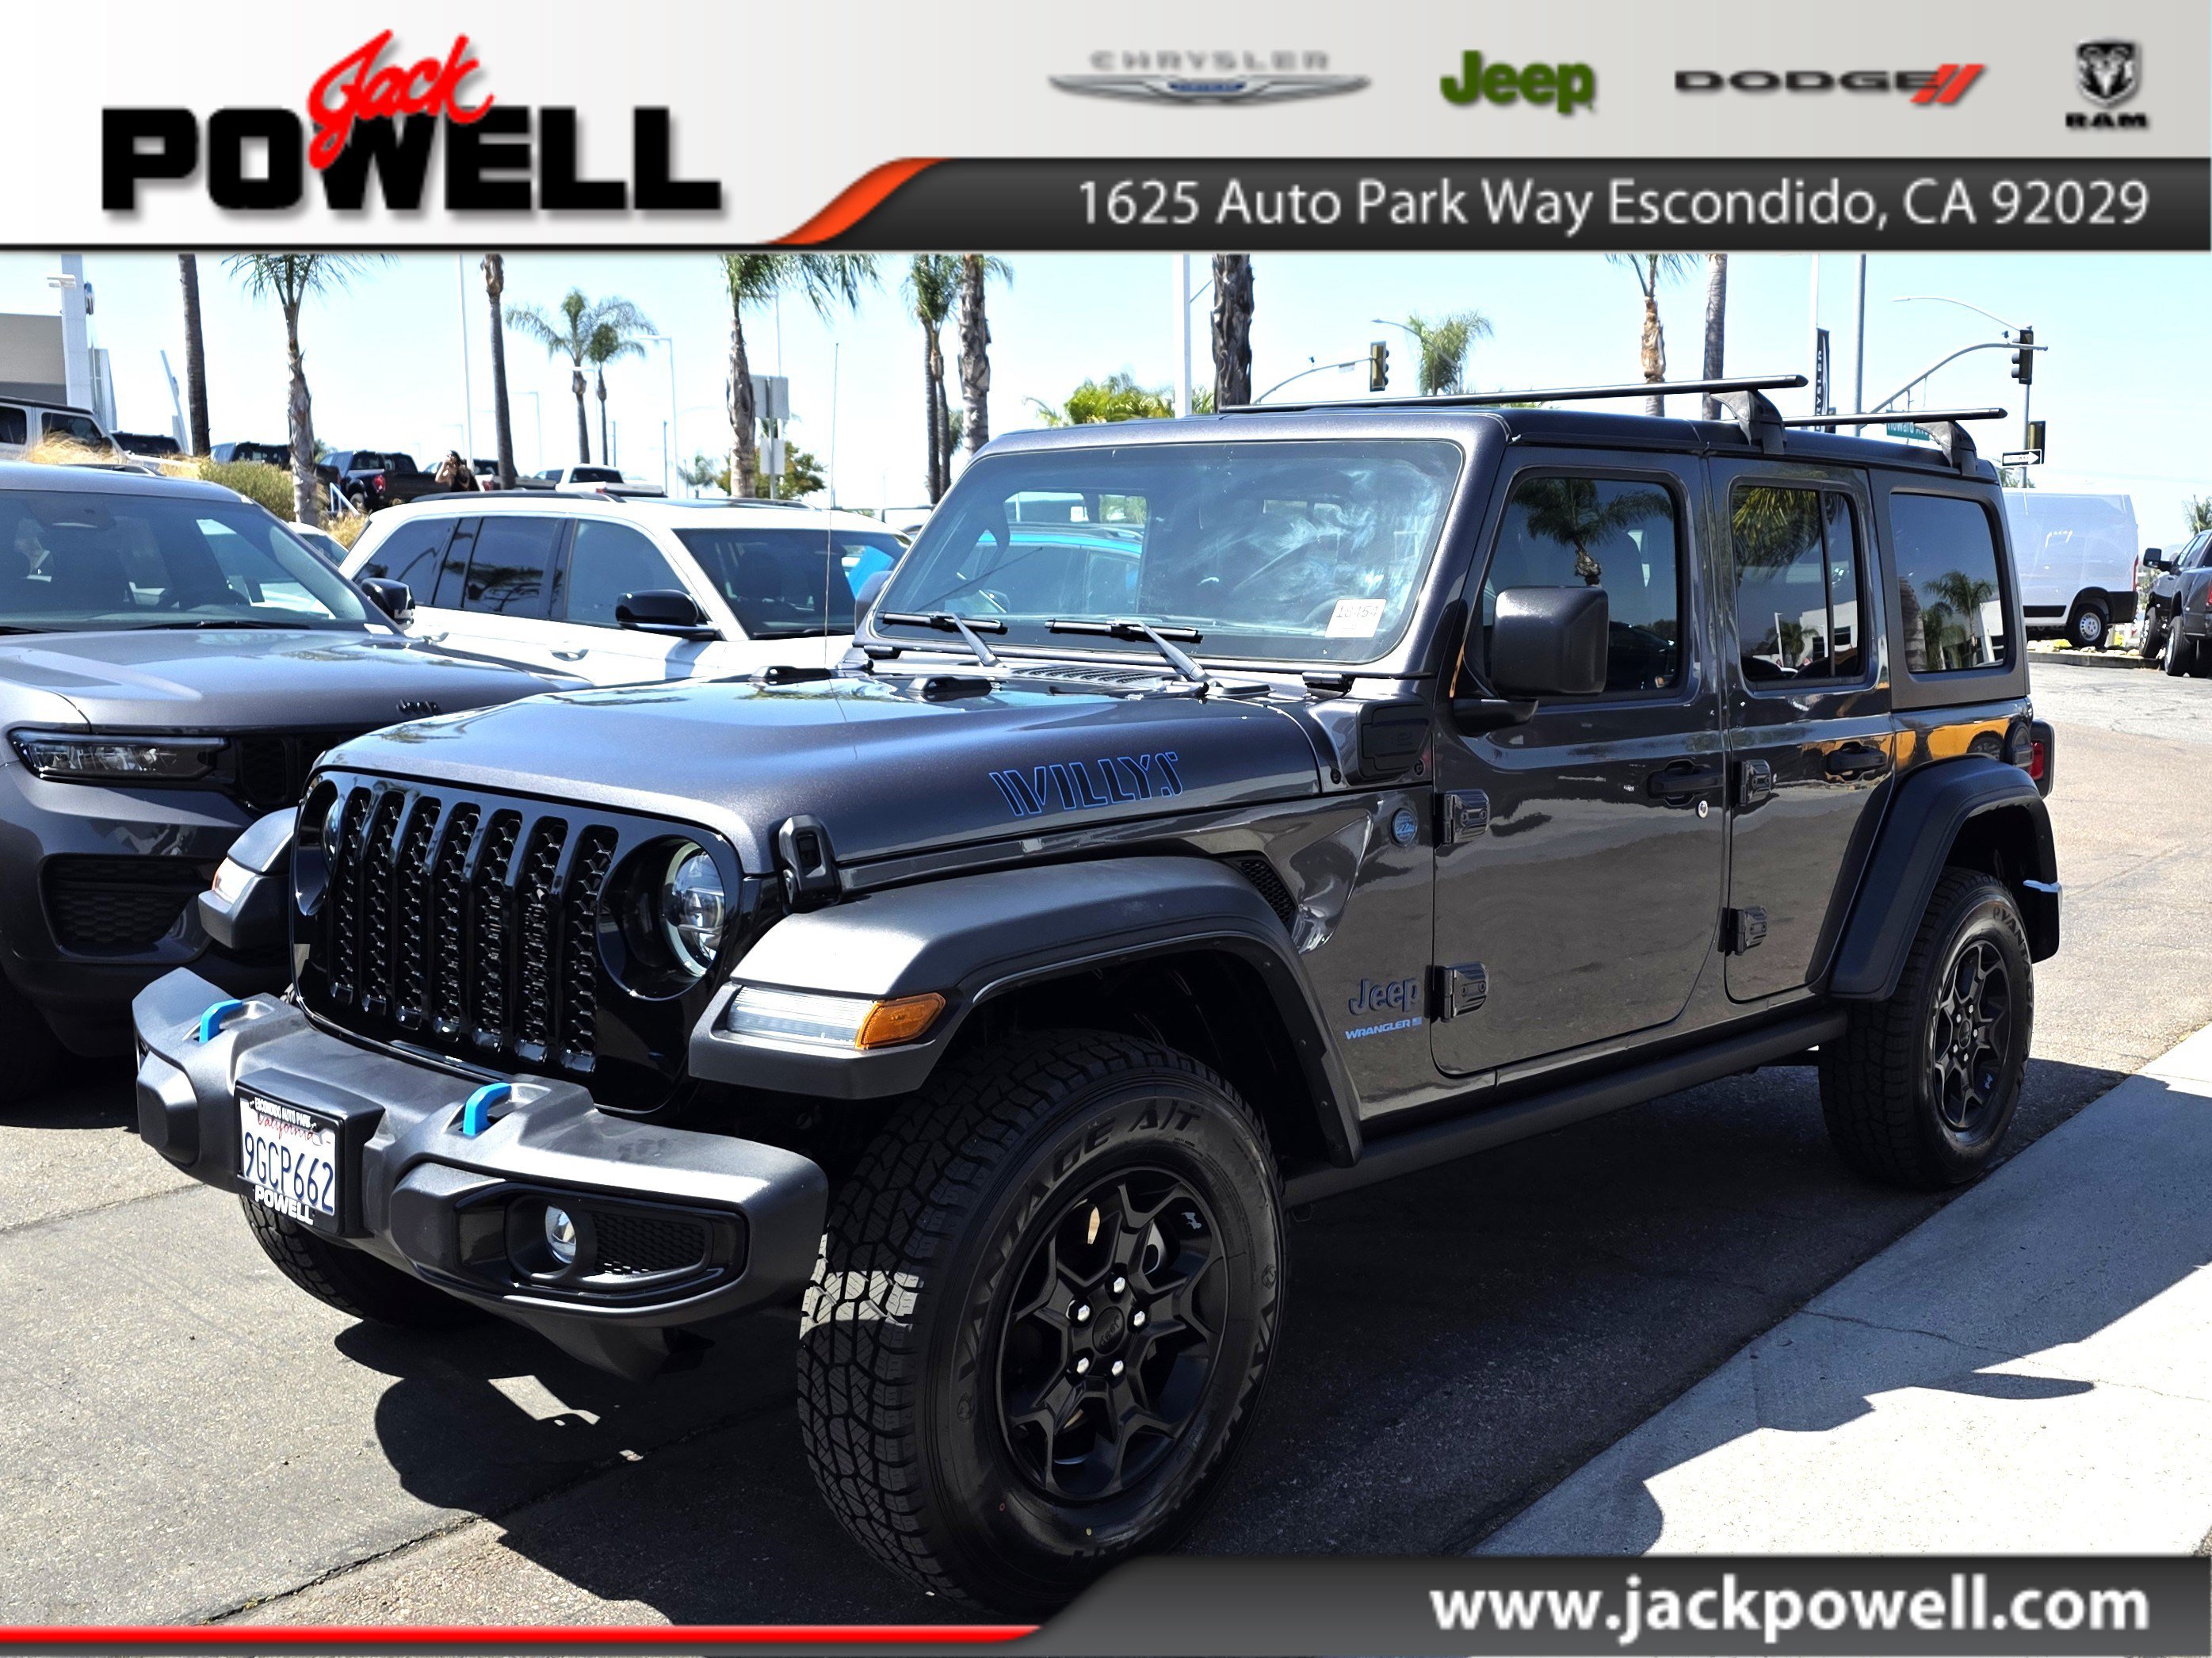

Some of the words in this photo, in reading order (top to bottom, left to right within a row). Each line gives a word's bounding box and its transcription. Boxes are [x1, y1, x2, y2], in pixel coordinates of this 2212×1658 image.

[988, 751, 1183, 817] WILLYS
[1348, 977, 1420, 1015] Jeep
[1345, 1018, 1411, 1041] WRANGLER
[245, 1131, 334, 1213] 9GCP662
[254, 1184, 314, 1226] POWELL
